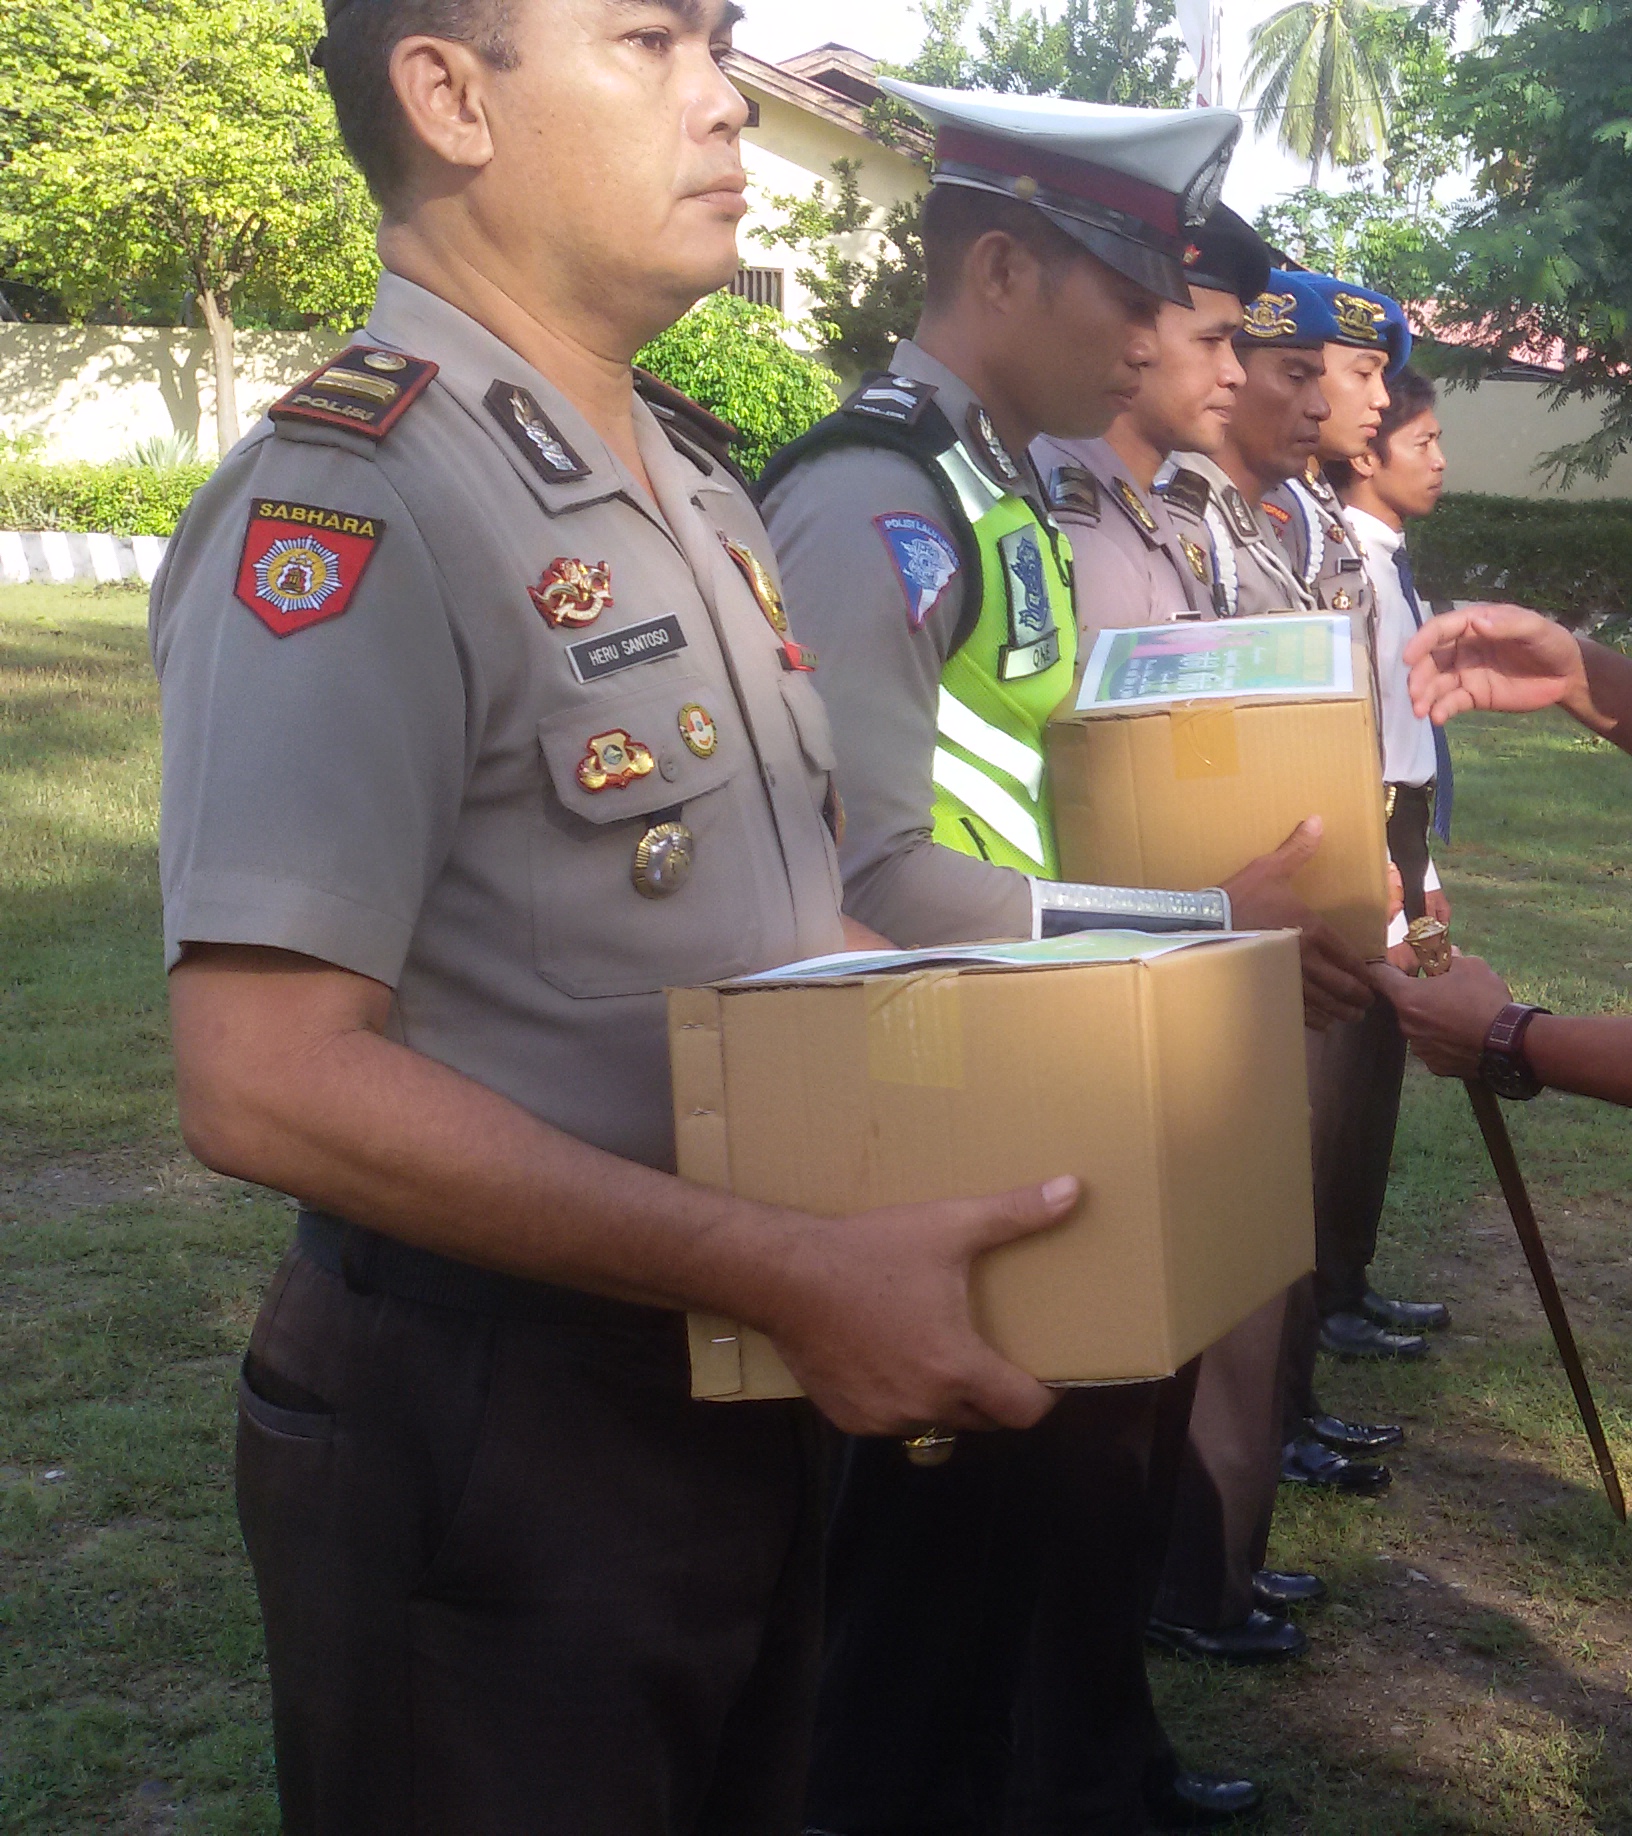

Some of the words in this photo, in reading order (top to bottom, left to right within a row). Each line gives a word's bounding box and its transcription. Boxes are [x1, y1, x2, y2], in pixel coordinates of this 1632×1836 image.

[258, 502, 376, 538] SABHARA
[588, 645, 618, 666] HERU
[622, 629, 669, 655] SANTOSO
